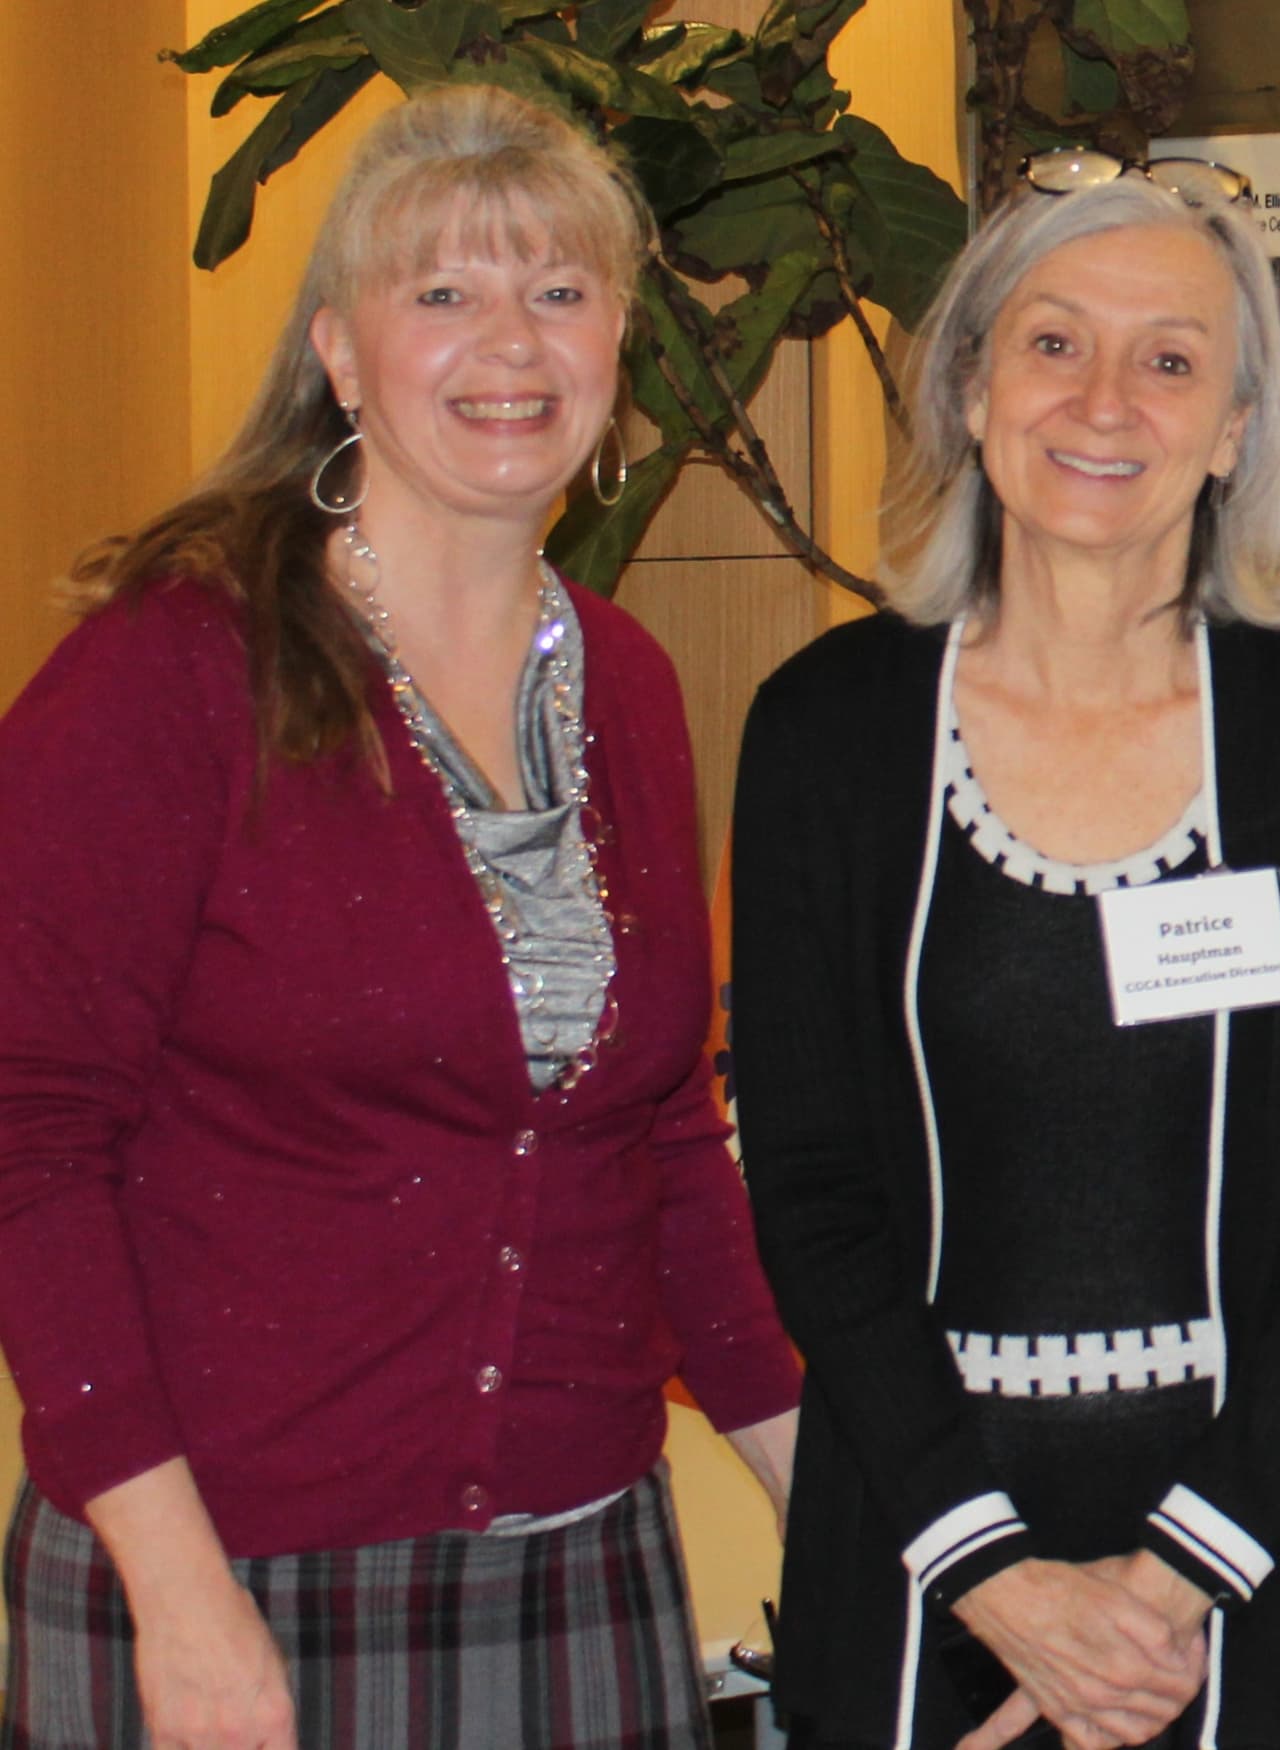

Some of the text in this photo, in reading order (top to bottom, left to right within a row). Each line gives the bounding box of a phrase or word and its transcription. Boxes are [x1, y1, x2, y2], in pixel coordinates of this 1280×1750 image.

[1160, 915, 1233, 938] Patrice
[1157, 944, 1243, 966] Hauptman
[1229, 962, 1280, 979] Director
